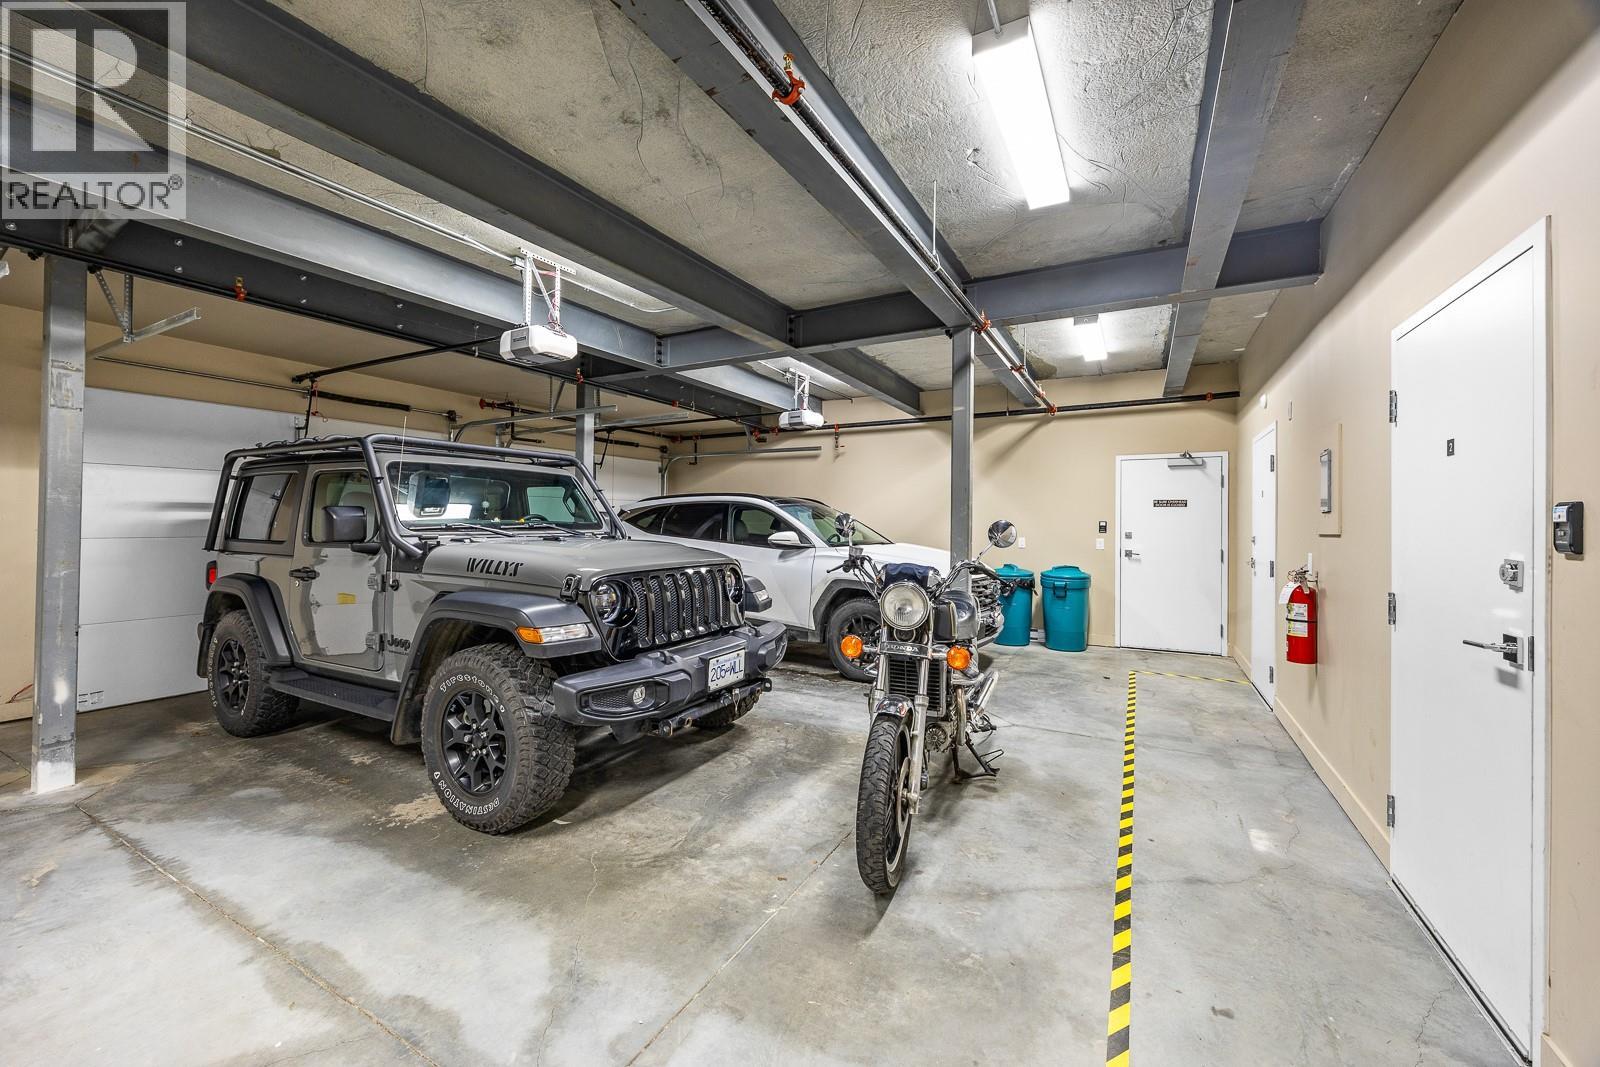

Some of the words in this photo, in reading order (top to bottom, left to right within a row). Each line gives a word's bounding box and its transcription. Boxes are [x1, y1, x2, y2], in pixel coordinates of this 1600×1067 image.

[466, 557, 525, 577] WILLYS
[387, 634, 411, 652] Jeep
[438, 781, 501, 816] DESTINATION
